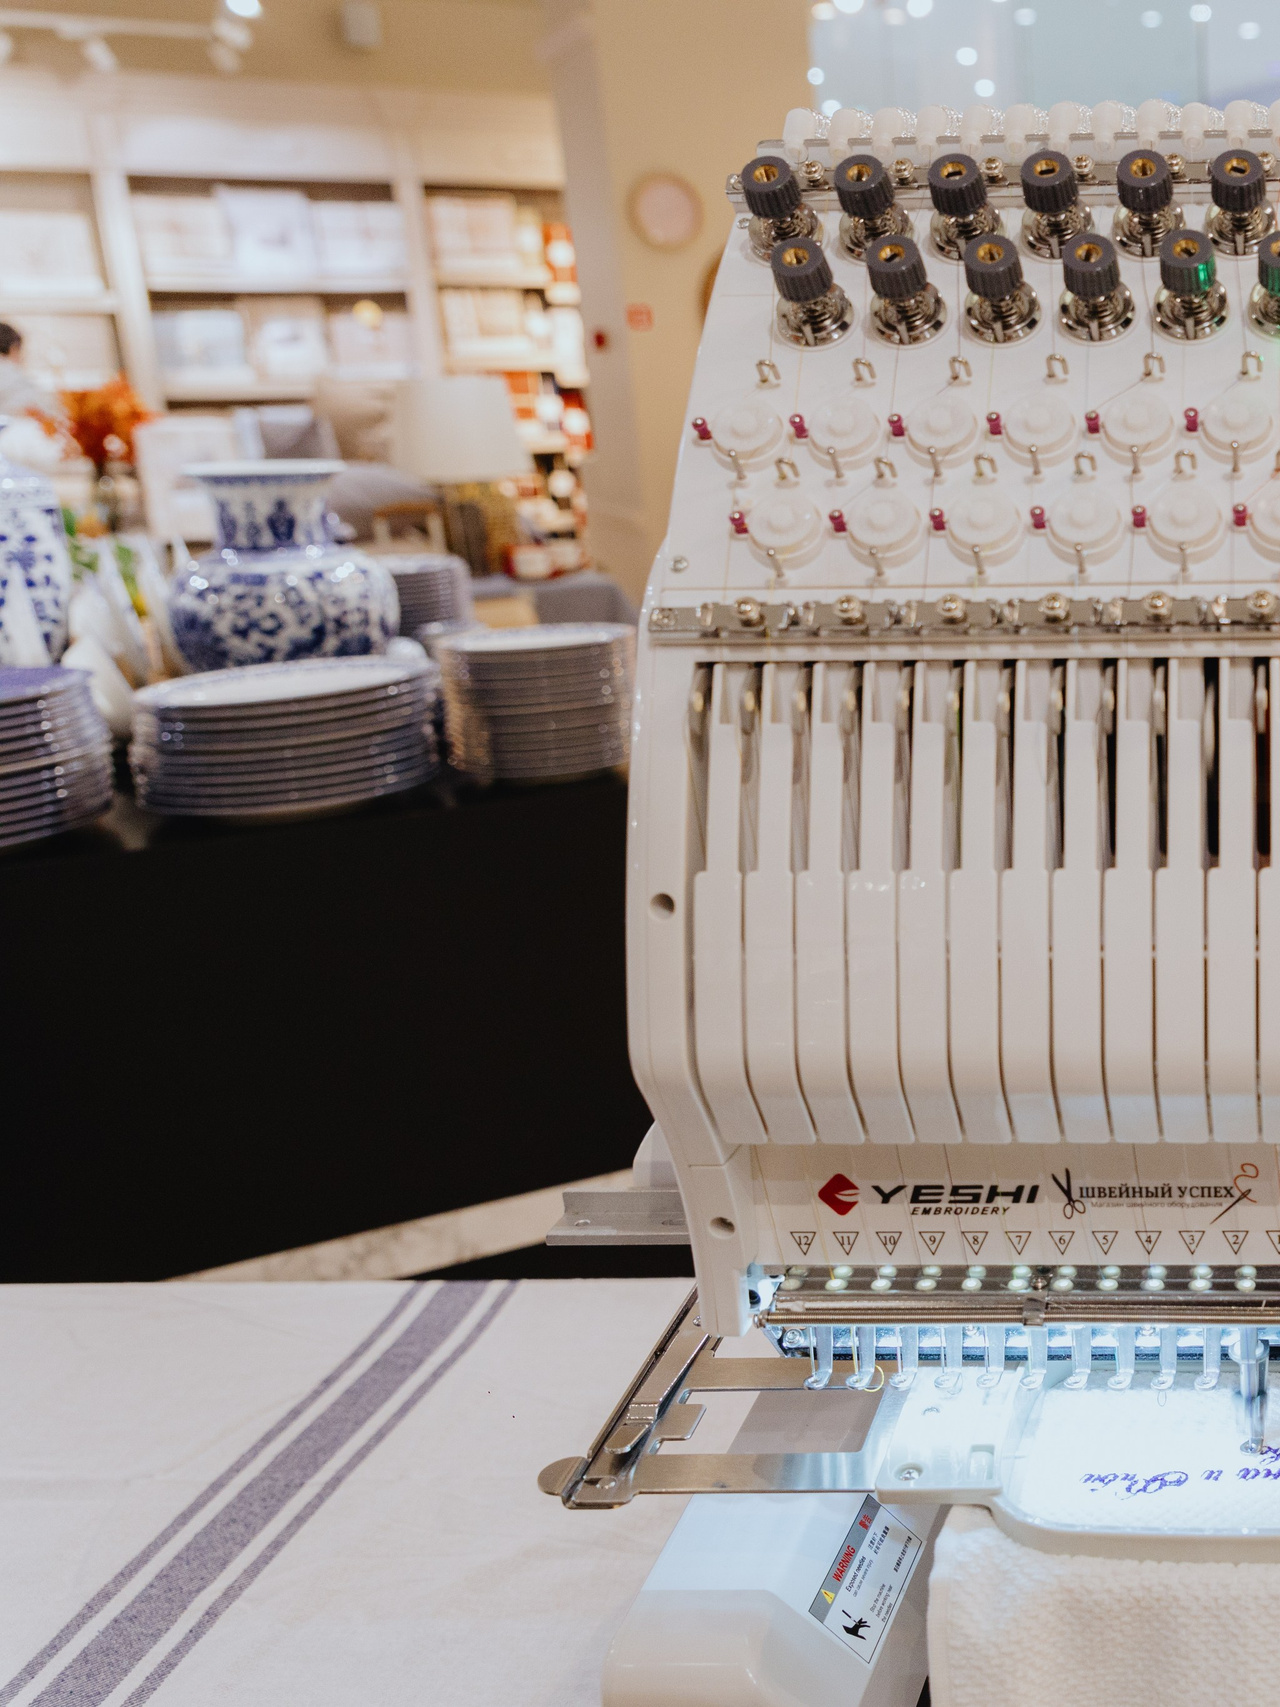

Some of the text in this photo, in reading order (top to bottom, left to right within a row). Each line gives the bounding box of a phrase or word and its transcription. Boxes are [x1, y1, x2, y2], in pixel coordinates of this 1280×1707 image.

[871, 1184, 1040, 1204] YESHI
[1078, 1181, 1236, 1199] ШВЕЙНЫЙ УСПЕХ
[910, 1206, 1011, 1216] EMBROIDERY
[798, 1235, 810, 1247] 12
[840, 1235, 852, 1247] 11
[883, 1235, 896, 1247] 10
[929, 1235, 936, 1247] 9
[972, 1235, 980, 1247] 8
[1015, 1235, 1023, 1247] 7
[1059, 1235, 1067, 1247] 6
[1102, 1235, 1110, 1247] 5
[1144, 1235, 1153, 1247] 4
[1188, 1235, 1196, 1247] 3
[1232, 1235, 1240, 1247] 2
[1202, 1469, 1223, 1481] и
[832, 1544, 856, 1583] WARNING
[845, 1555, 866, 1593] Exposed needles
